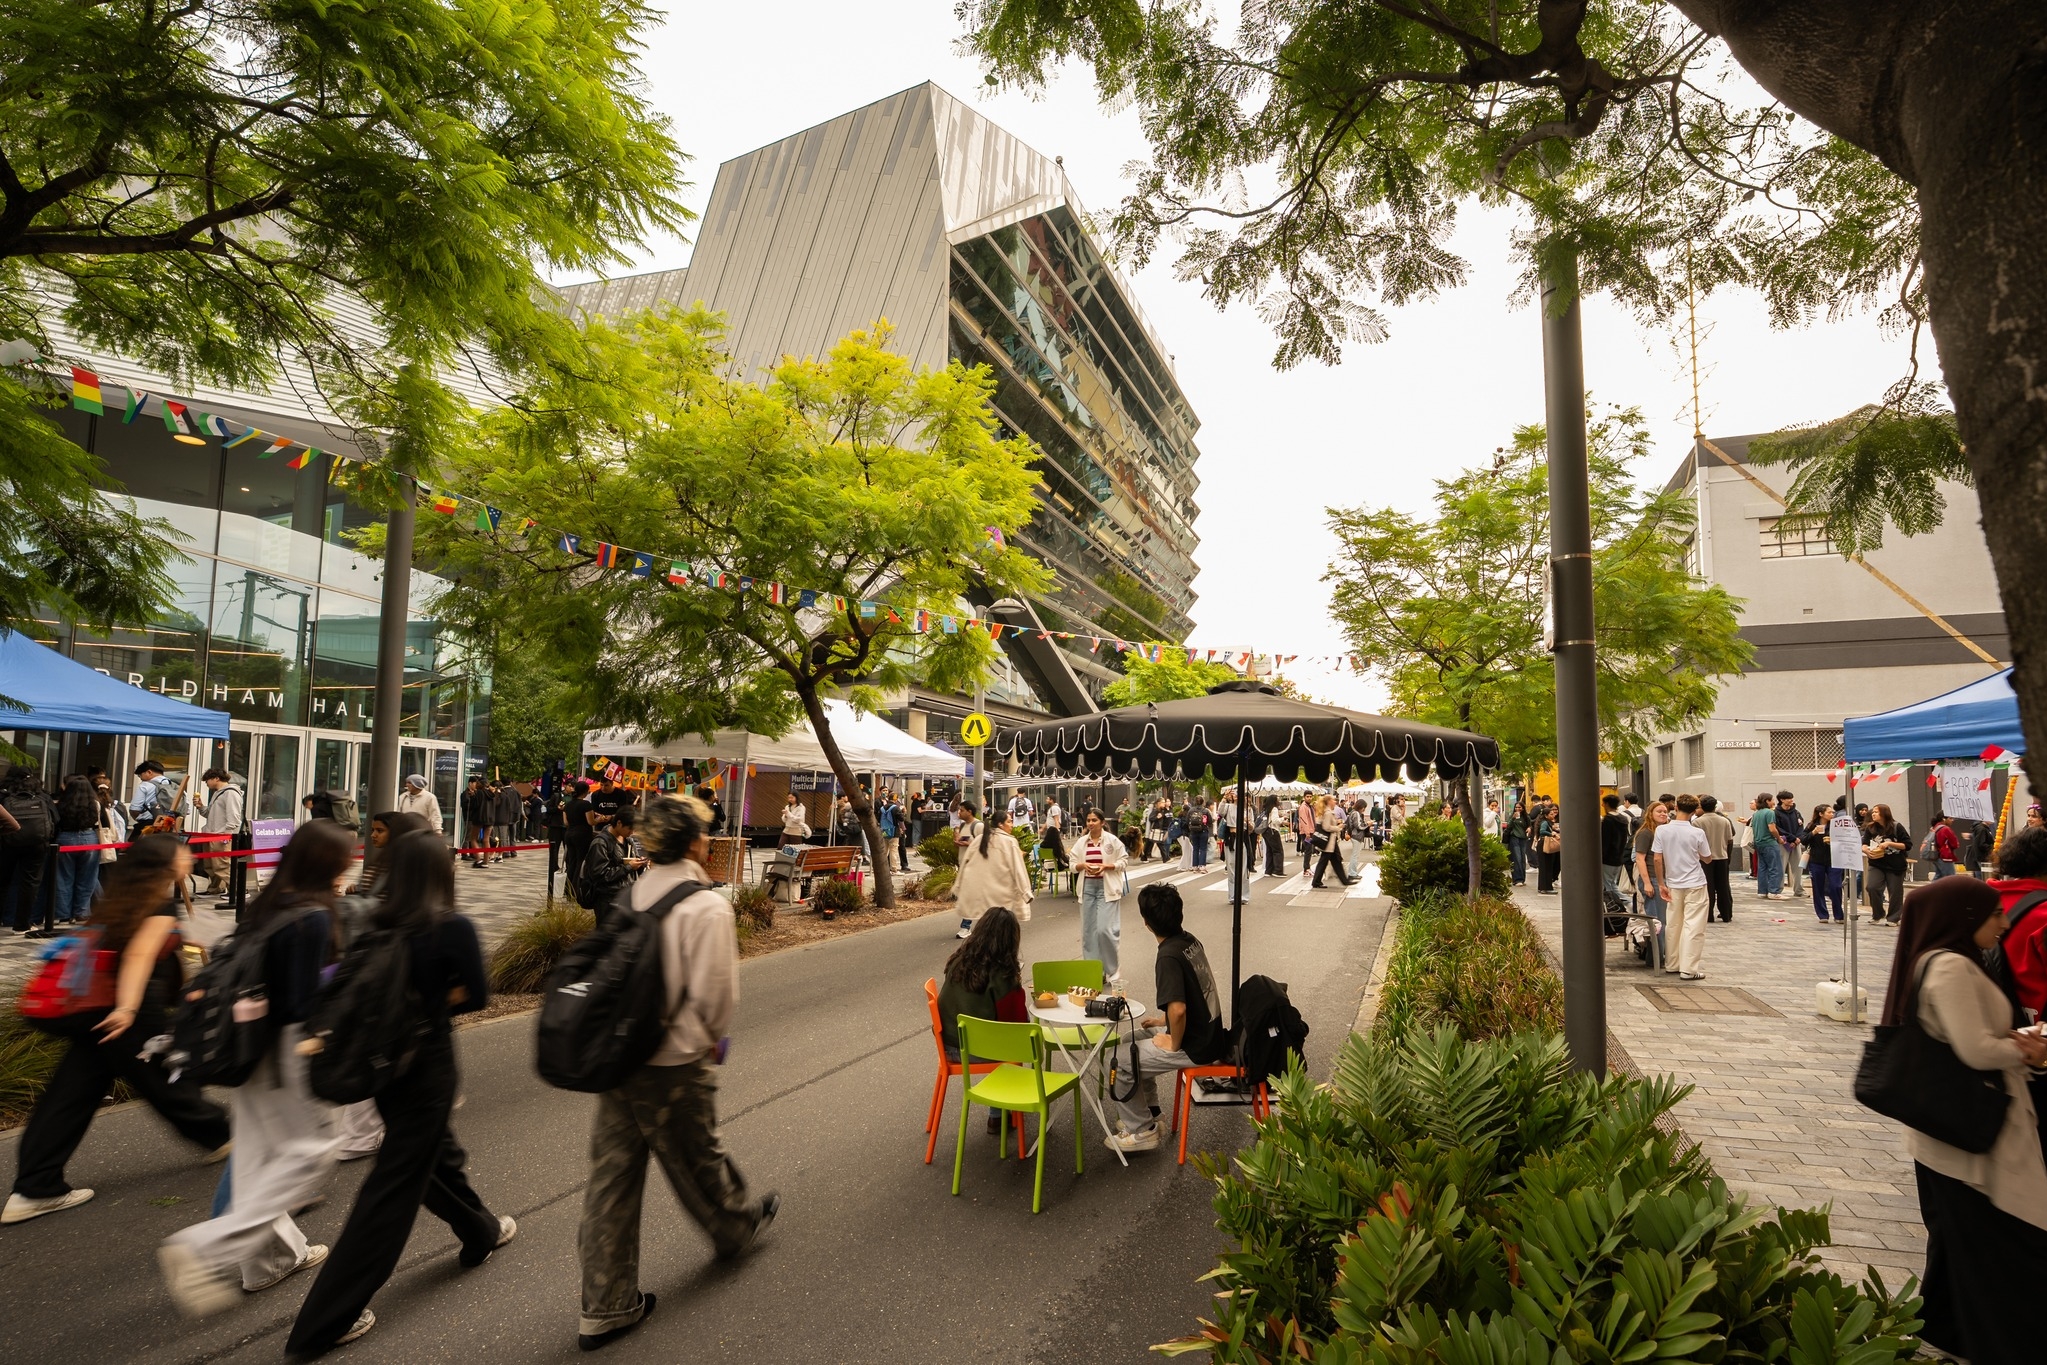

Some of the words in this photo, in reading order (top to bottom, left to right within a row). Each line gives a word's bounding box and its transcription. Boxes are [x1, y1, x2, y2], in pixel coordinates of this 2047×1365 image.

[313, 697, 367, 719] HAL
[791, 774, 832, 783] Multicutural
[1951, 776, 1971, 797] BAR
[255, 828, 275, 836] Gelato
[275, 828, 291, 836] Bella
